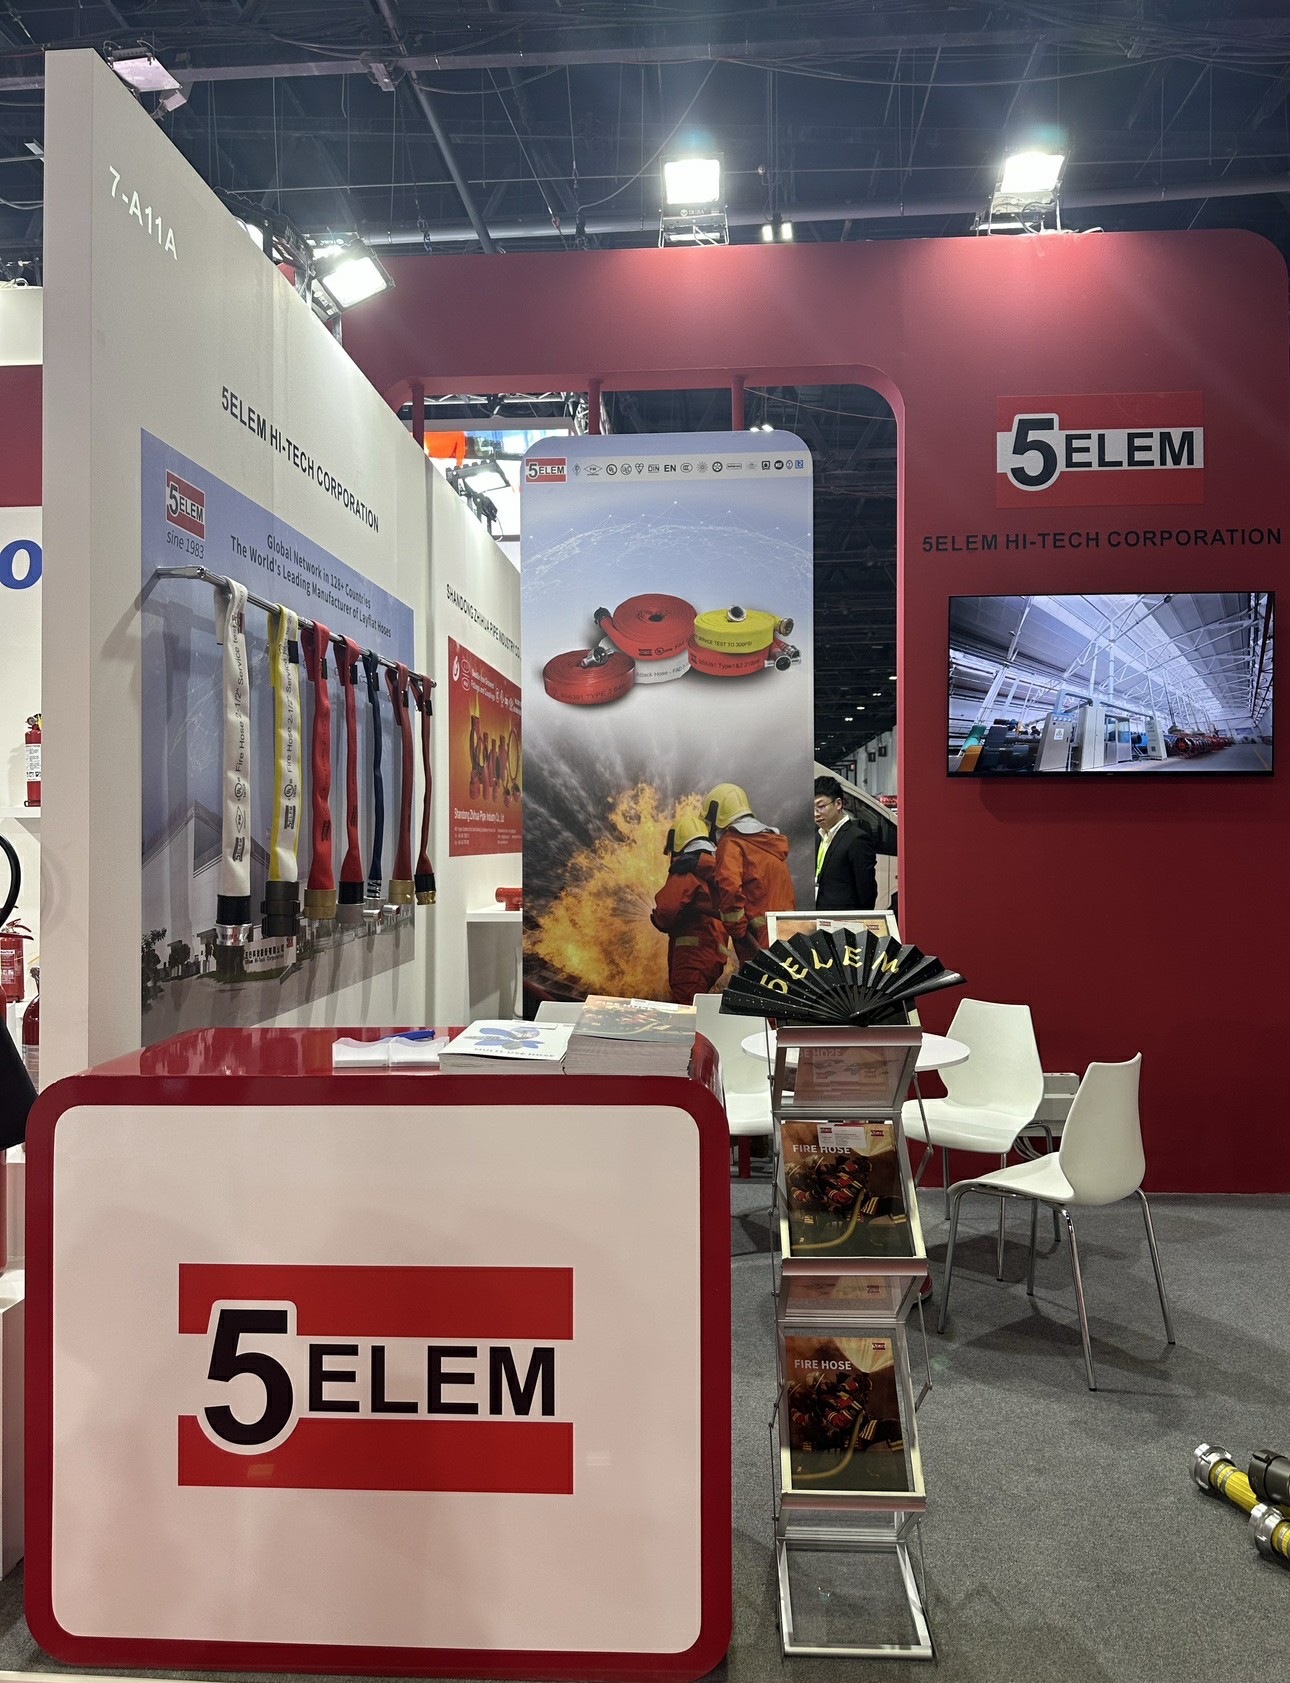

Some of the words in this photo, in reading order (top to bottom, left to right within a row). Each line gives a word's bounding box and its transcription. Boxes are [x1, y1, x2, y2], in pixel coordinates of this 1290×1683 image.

[109, 165, 177, 260] 7-A11A
[221, 385, 267, 442] 5ELEM
[270, 424, 314, 480] HI-TECH
[317, 465, 379, 533] CORPORATION
[528, 463, 565, 478] 5ELEM
[1009, 417, 1196, 487] 5ELEM
[169, 483, 204, 523] 5ELEM
[186, 538, 205, 559] 1983
[921, 534, 999, 553] 5ELEM
[1005, 531, 1100, 551] HI-TECH
[1107, 527, 1283, 549] CORPORATION
[230, 535, 247, 558] The
[250, 546, 281, 576] World's
[283, 565, 311, 597] Leading
[312, 582, 352, 615] Manufacturer
[353, 607, 359, 620] of
[378, 620, 392, 638] Hoses
[267, 534, 292, 561] Global
[294, 550, 322, 580] Network
[323, 568, 330, 583] in
[345, 583, 371, 609] Countries
[235, 646, 244, 686] Service
[238, 721, 246, 747] Hose
[235, 751, 245, 772] Fire
[792, 1144, 818, 1153] FIRE
[820, 1145, 851, 1154] HOSE
[203, 1308, 556, 1446] 5ELEM
[794, 1359, 819, 1369] FIRE
[821, 1360, 852, 1370] HOSE
